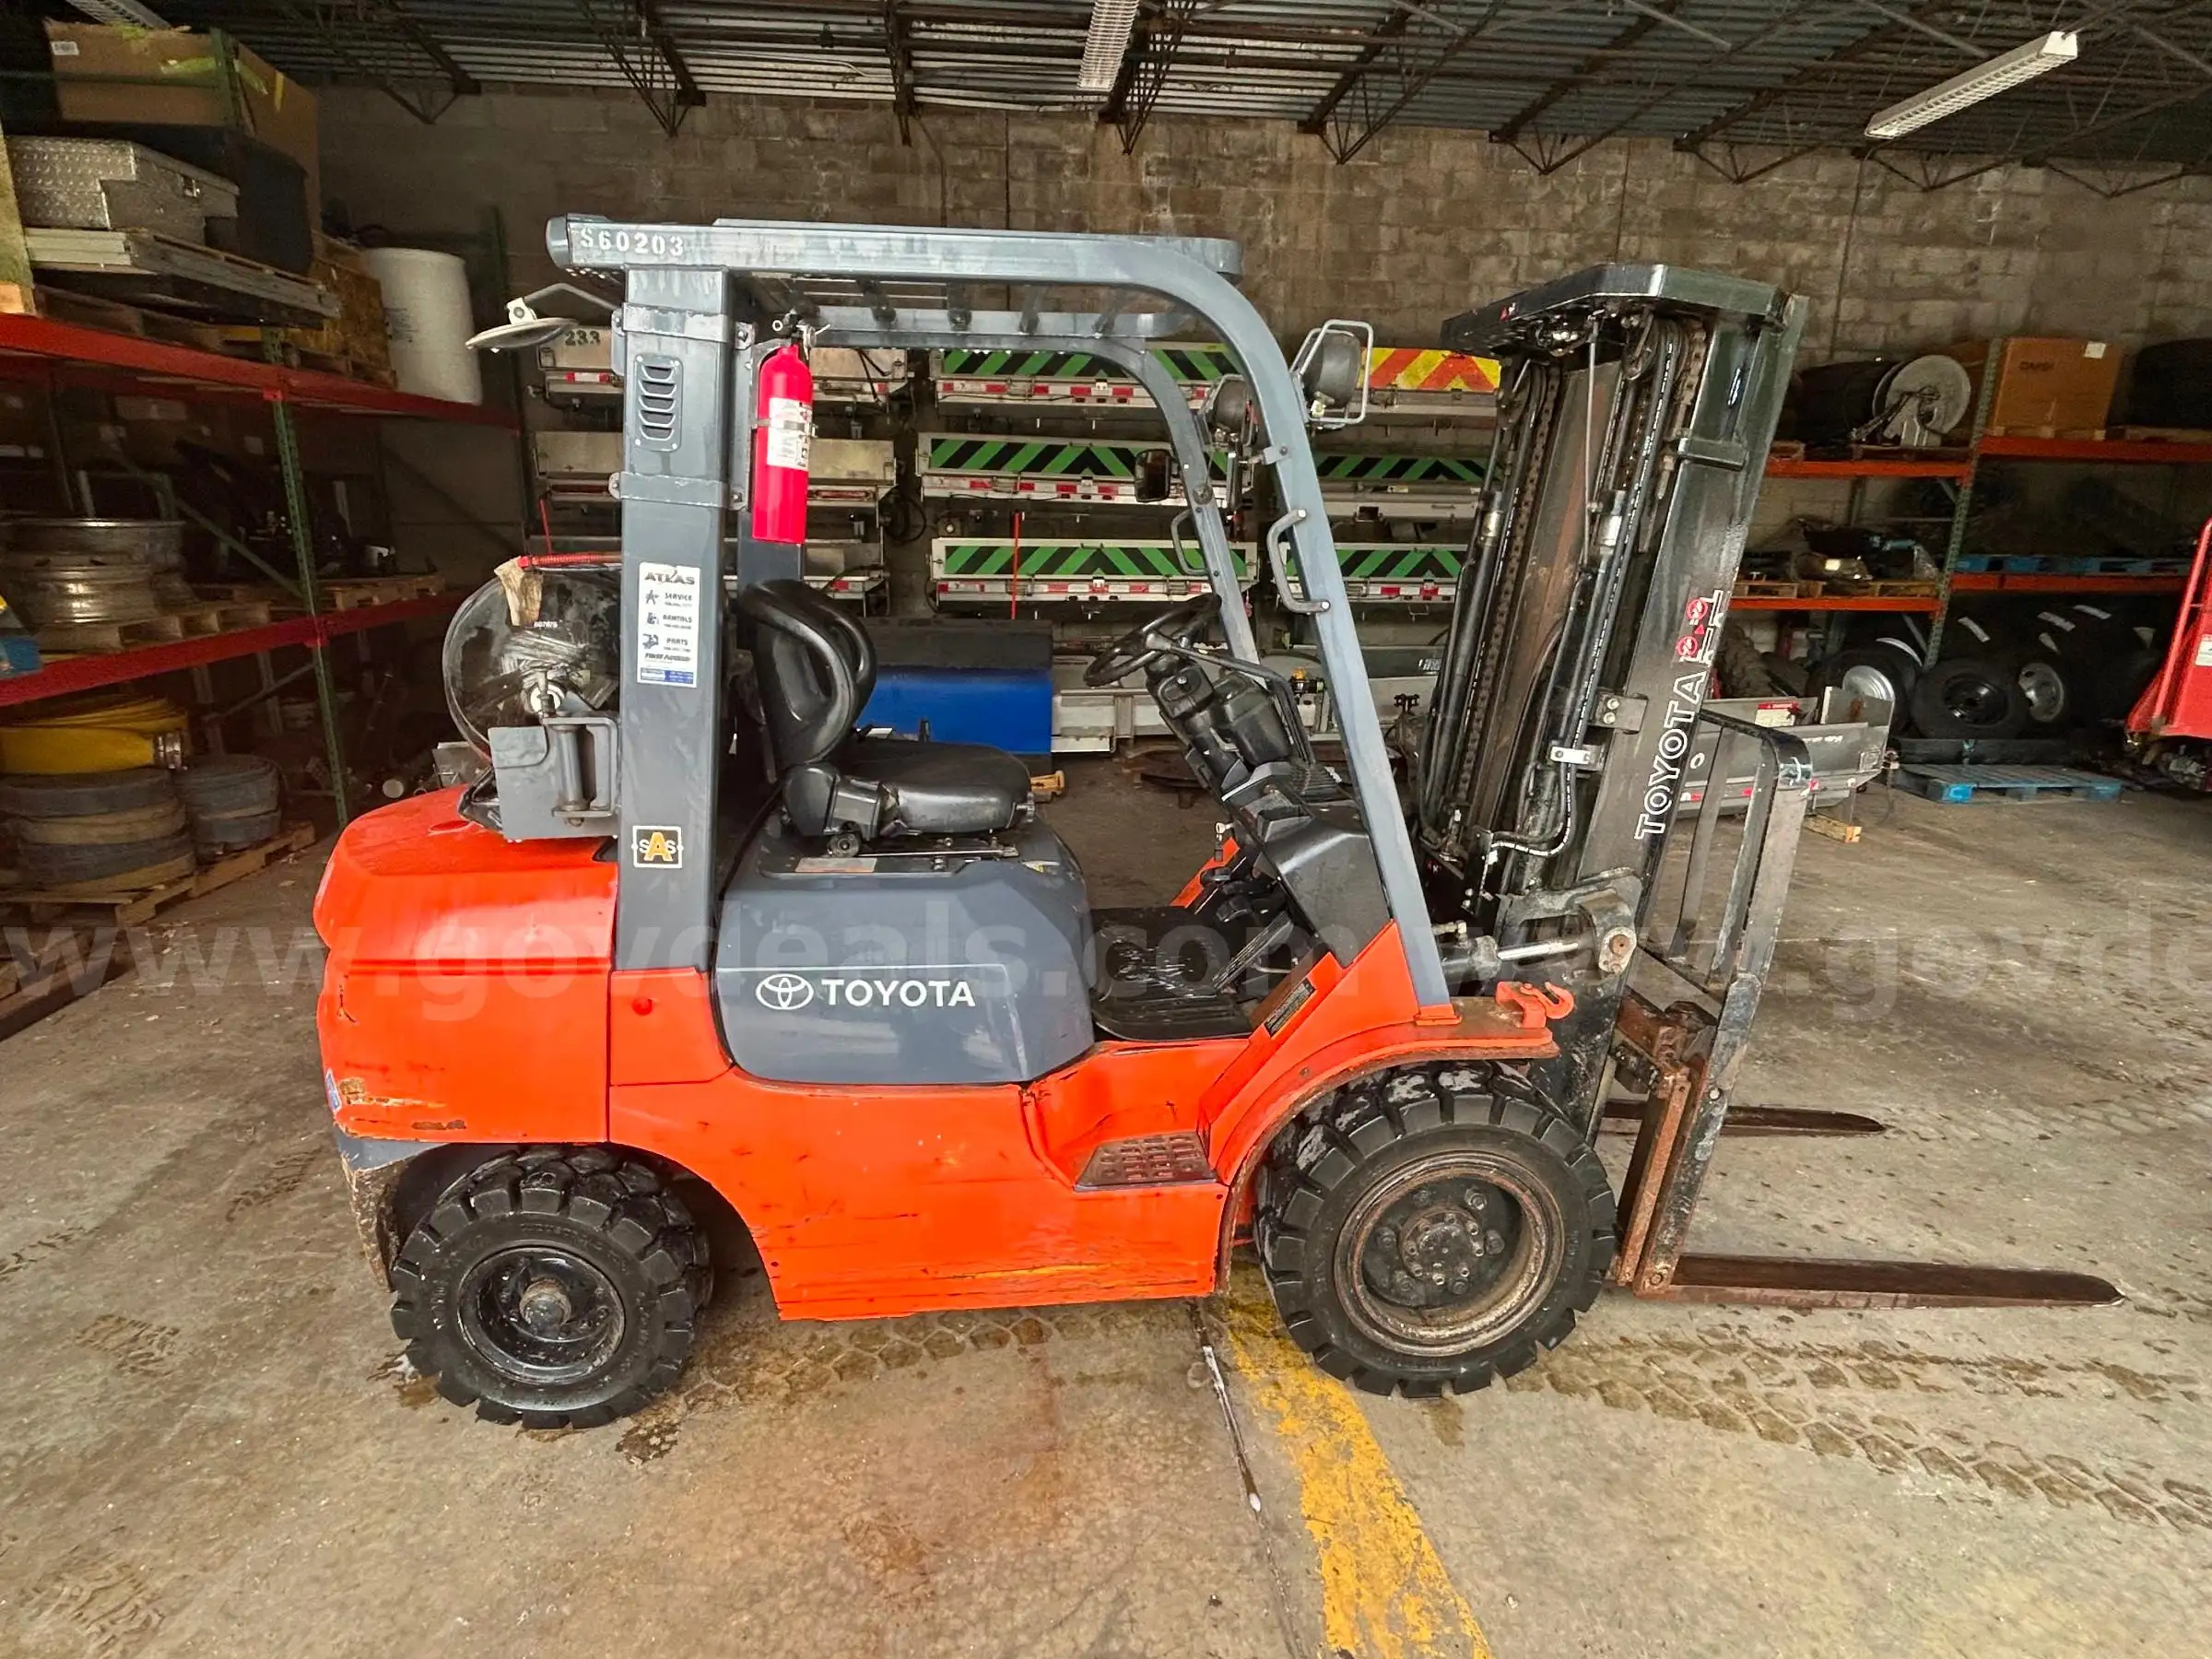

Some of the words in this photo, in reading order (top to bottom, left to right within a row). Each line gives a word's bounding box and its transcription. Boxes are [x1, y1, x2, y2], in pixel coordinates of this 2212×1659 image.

[580, 227, 684, 257] S60203
[644, 570, 695, 585] ATLAS
[665, 593, 692, 601] SERVICE
[666, 638, 688, 646] PARTS
[1633, 670, 1707, 840] TOYOTA
[820, 978, 977, 1007] TOYOTA
